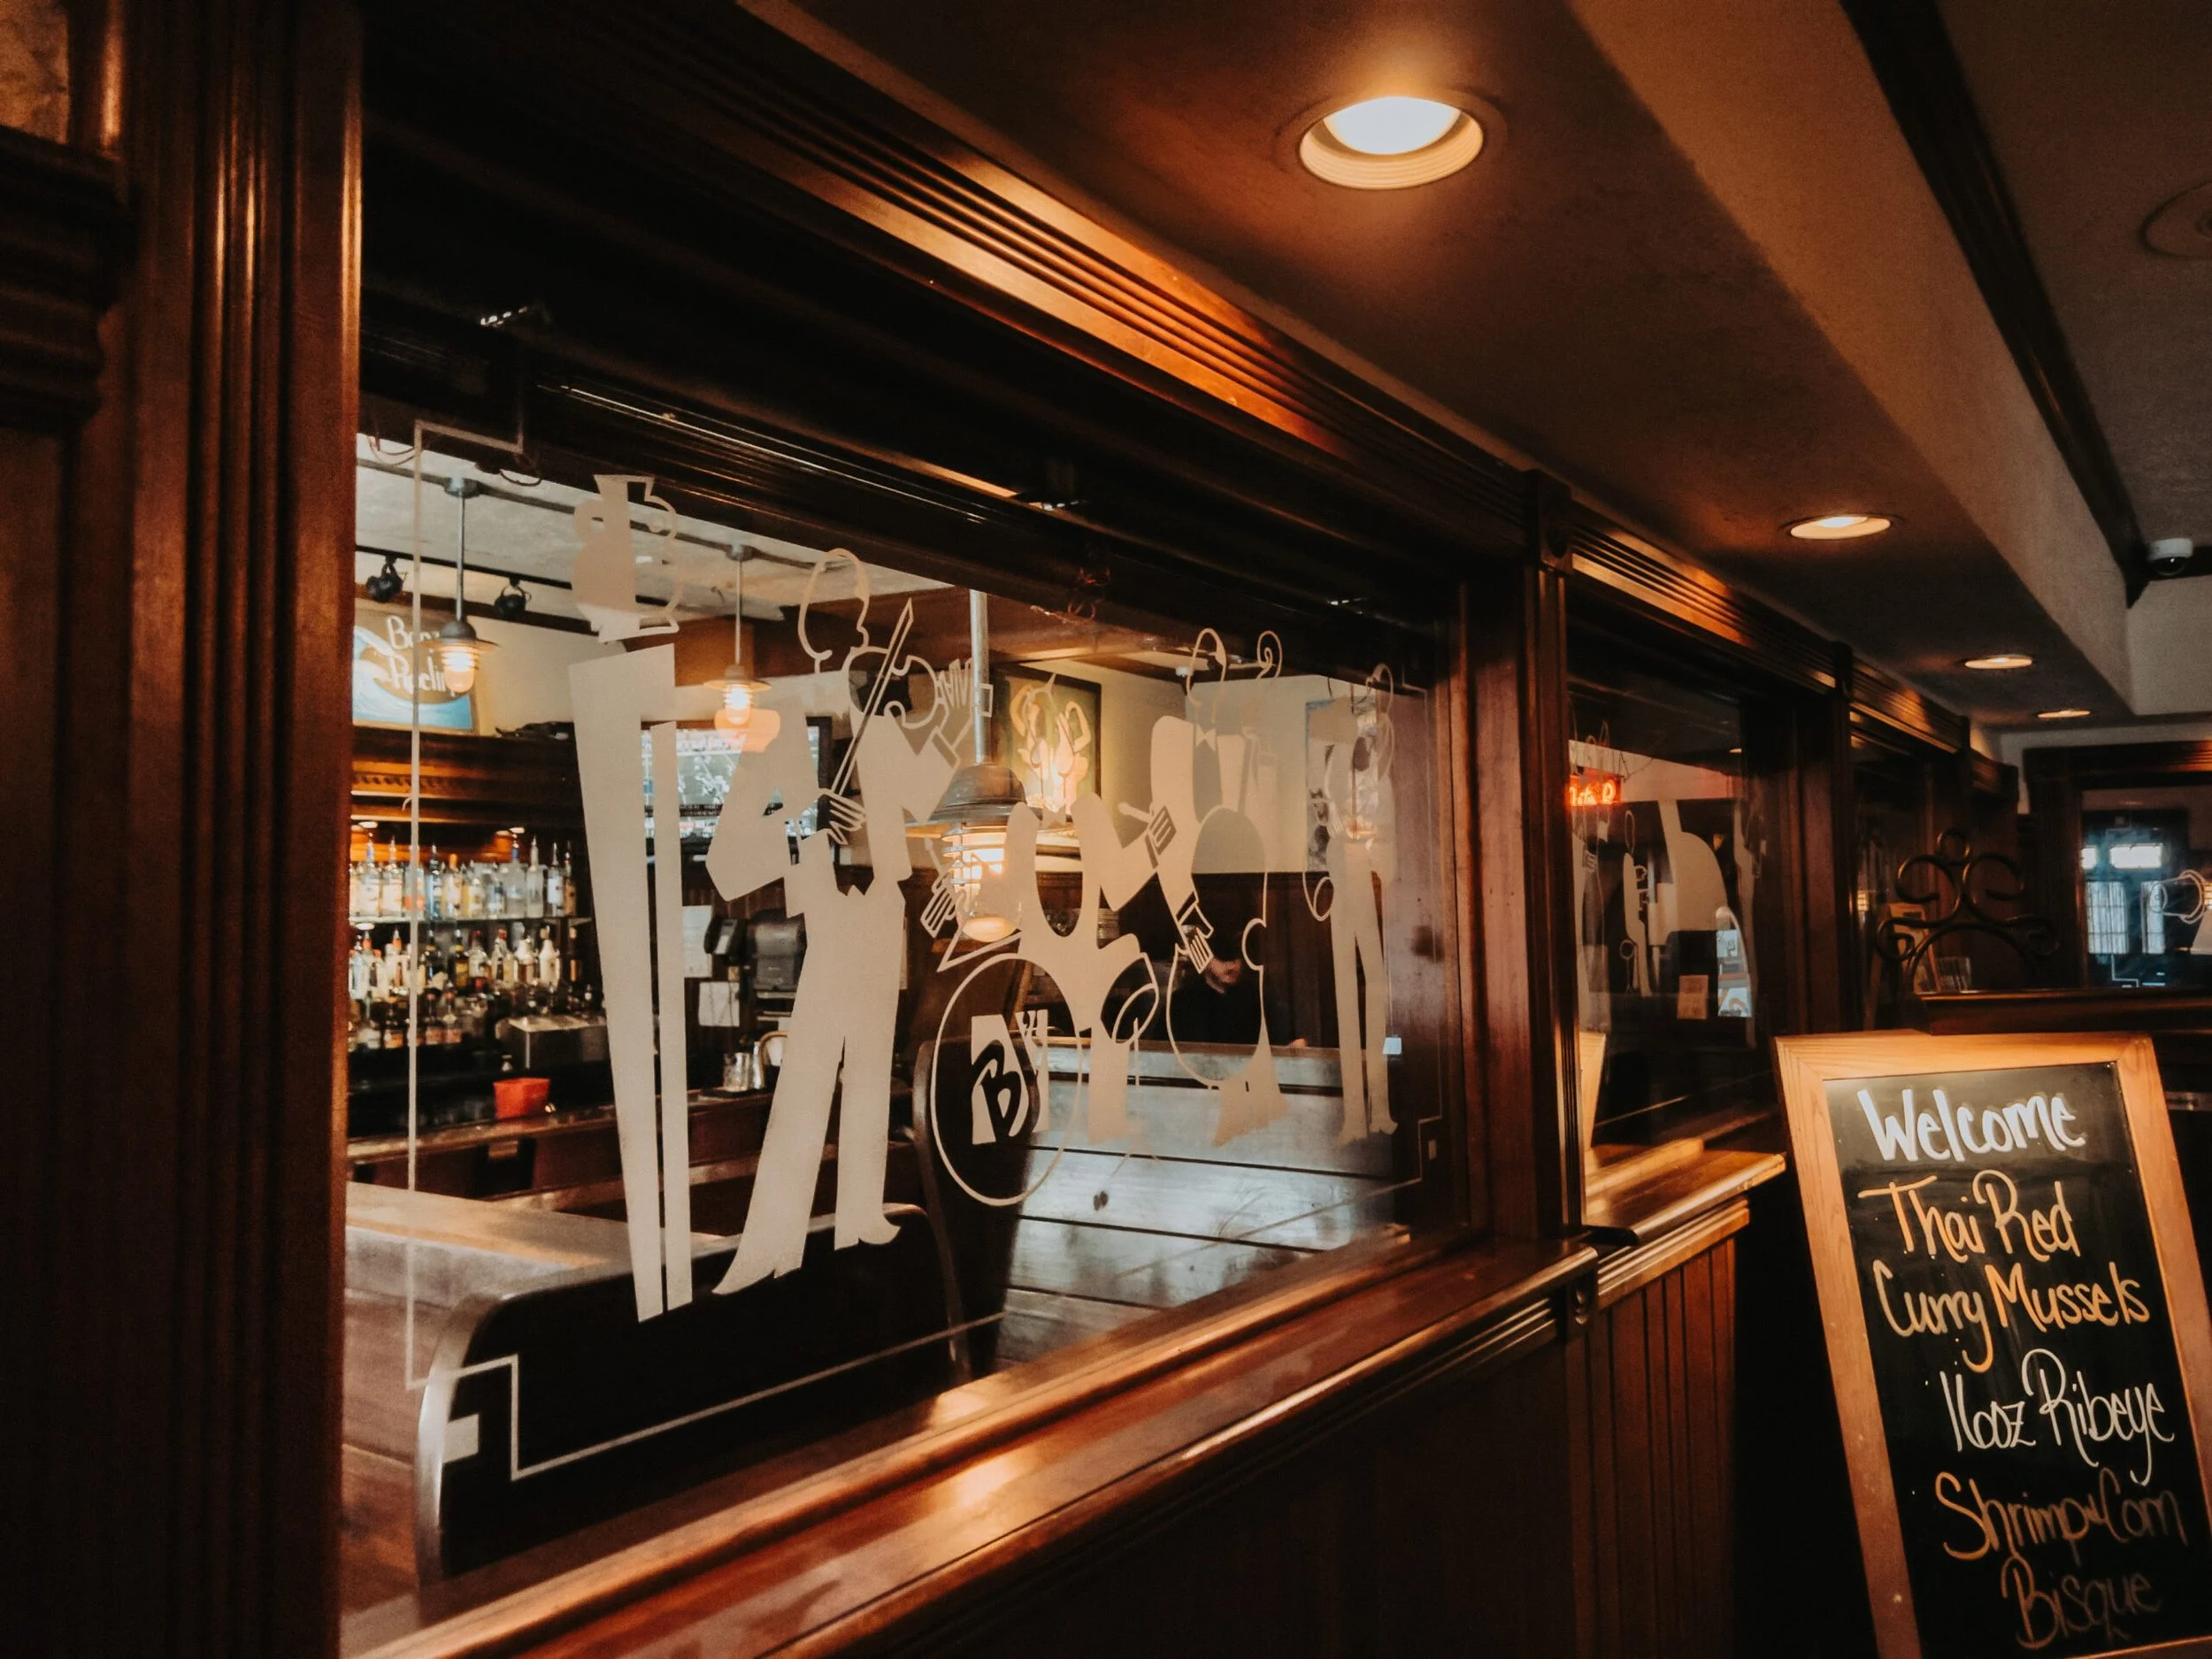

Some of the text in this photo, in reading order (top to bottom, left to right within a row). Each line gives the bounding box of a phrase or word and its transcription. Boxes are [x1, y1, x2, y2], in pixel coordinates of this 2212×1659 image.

[1858, 1089, 2086, 1162] Welcome
[1858, 1170, 2080, 1263] Thai Red
[1872, 1259, 2150, 1372] Curry Mussels
[2022, 1348, 2175, 1486] Ribeye
[1935, 1471, 2089, 1567] Shrimp
[2001, 1555, 2162, 1650] Bisque
